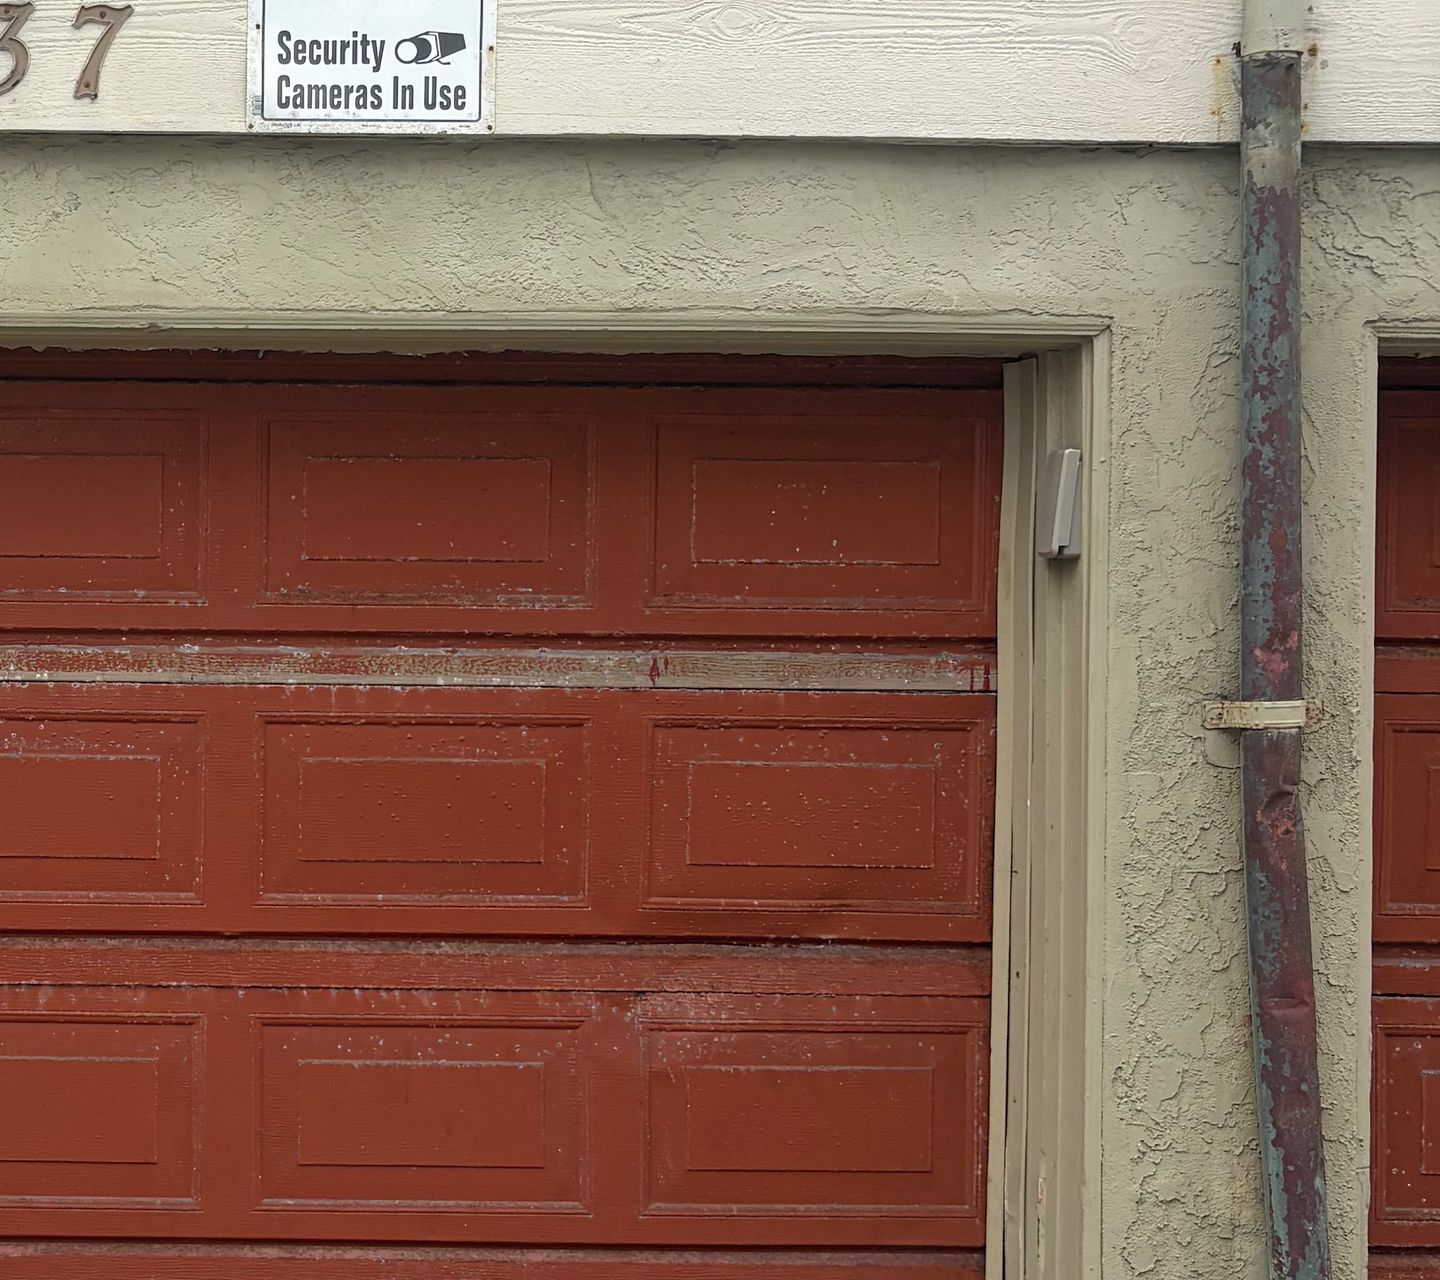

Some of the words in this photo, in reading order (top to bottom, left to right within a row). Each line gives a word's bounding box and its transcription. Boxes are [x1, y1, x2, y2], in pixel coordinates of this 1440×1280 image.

[277, 30, 386, 73] Security
[277, 74, 383, 111] Cameras
[392, 75, 414, 110] In
[423, 75, 467, 111] Use
